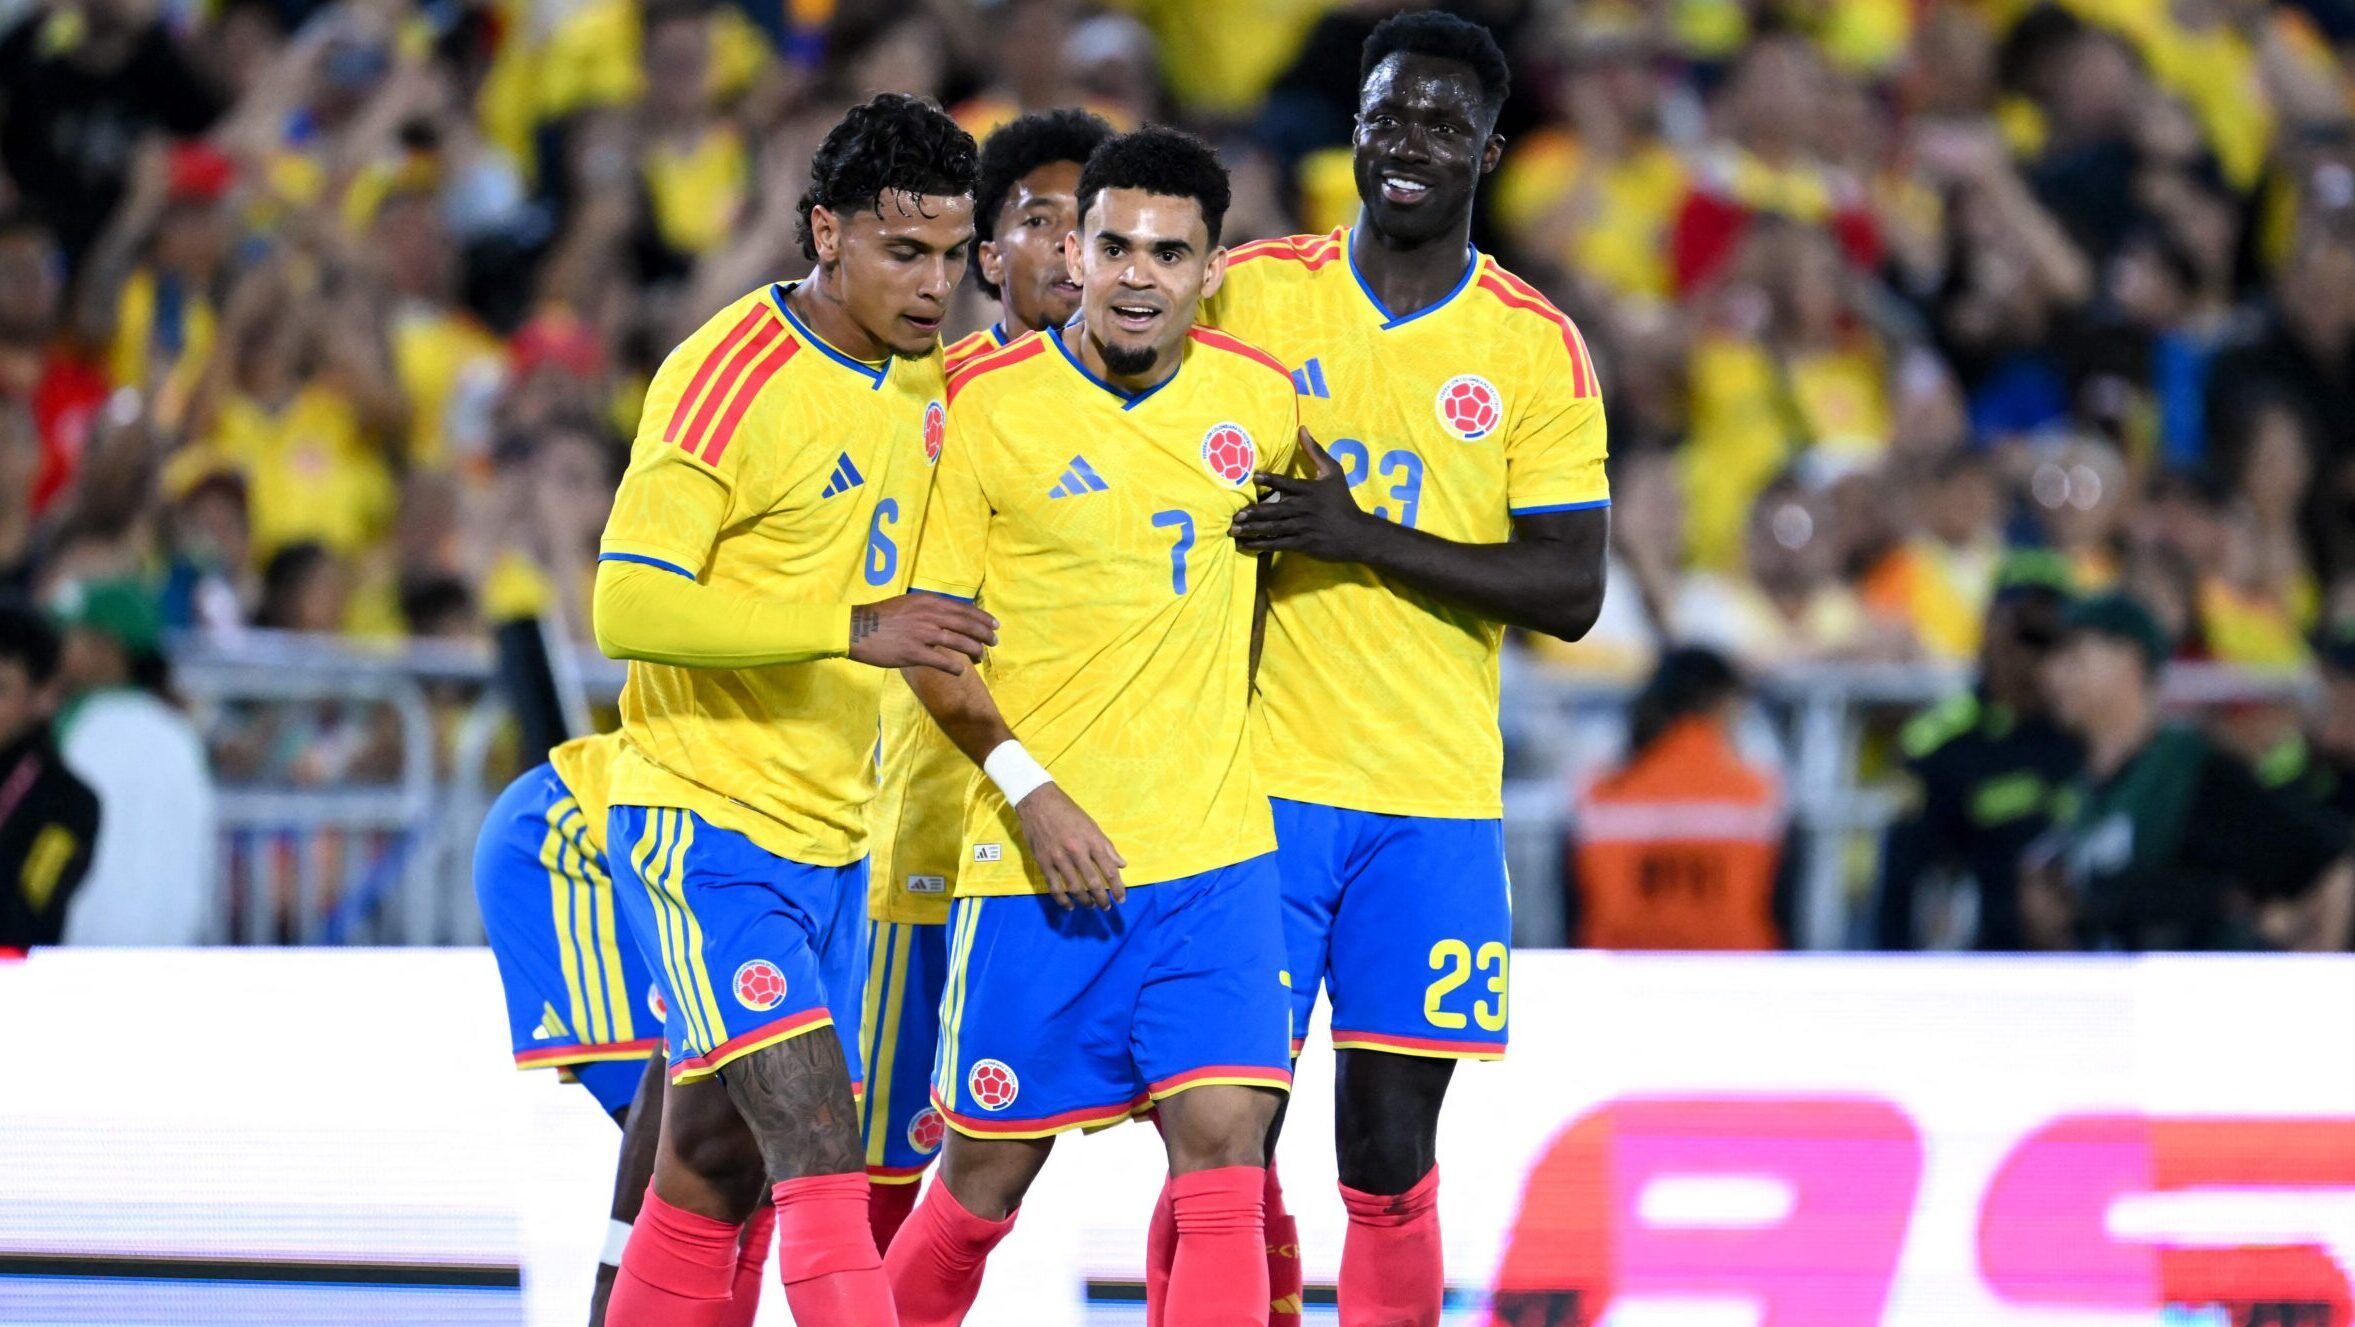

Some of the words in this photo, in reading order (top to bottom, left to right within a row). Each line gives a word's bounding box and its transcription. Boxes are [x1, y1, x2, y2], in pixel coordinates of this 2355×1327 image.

[1327, 438, 1424, 529] 23
[864, 497, 899, 587] 6
[1151, 509, 1195, 596] 7
[1424, 938, 1509, 1031] 23
